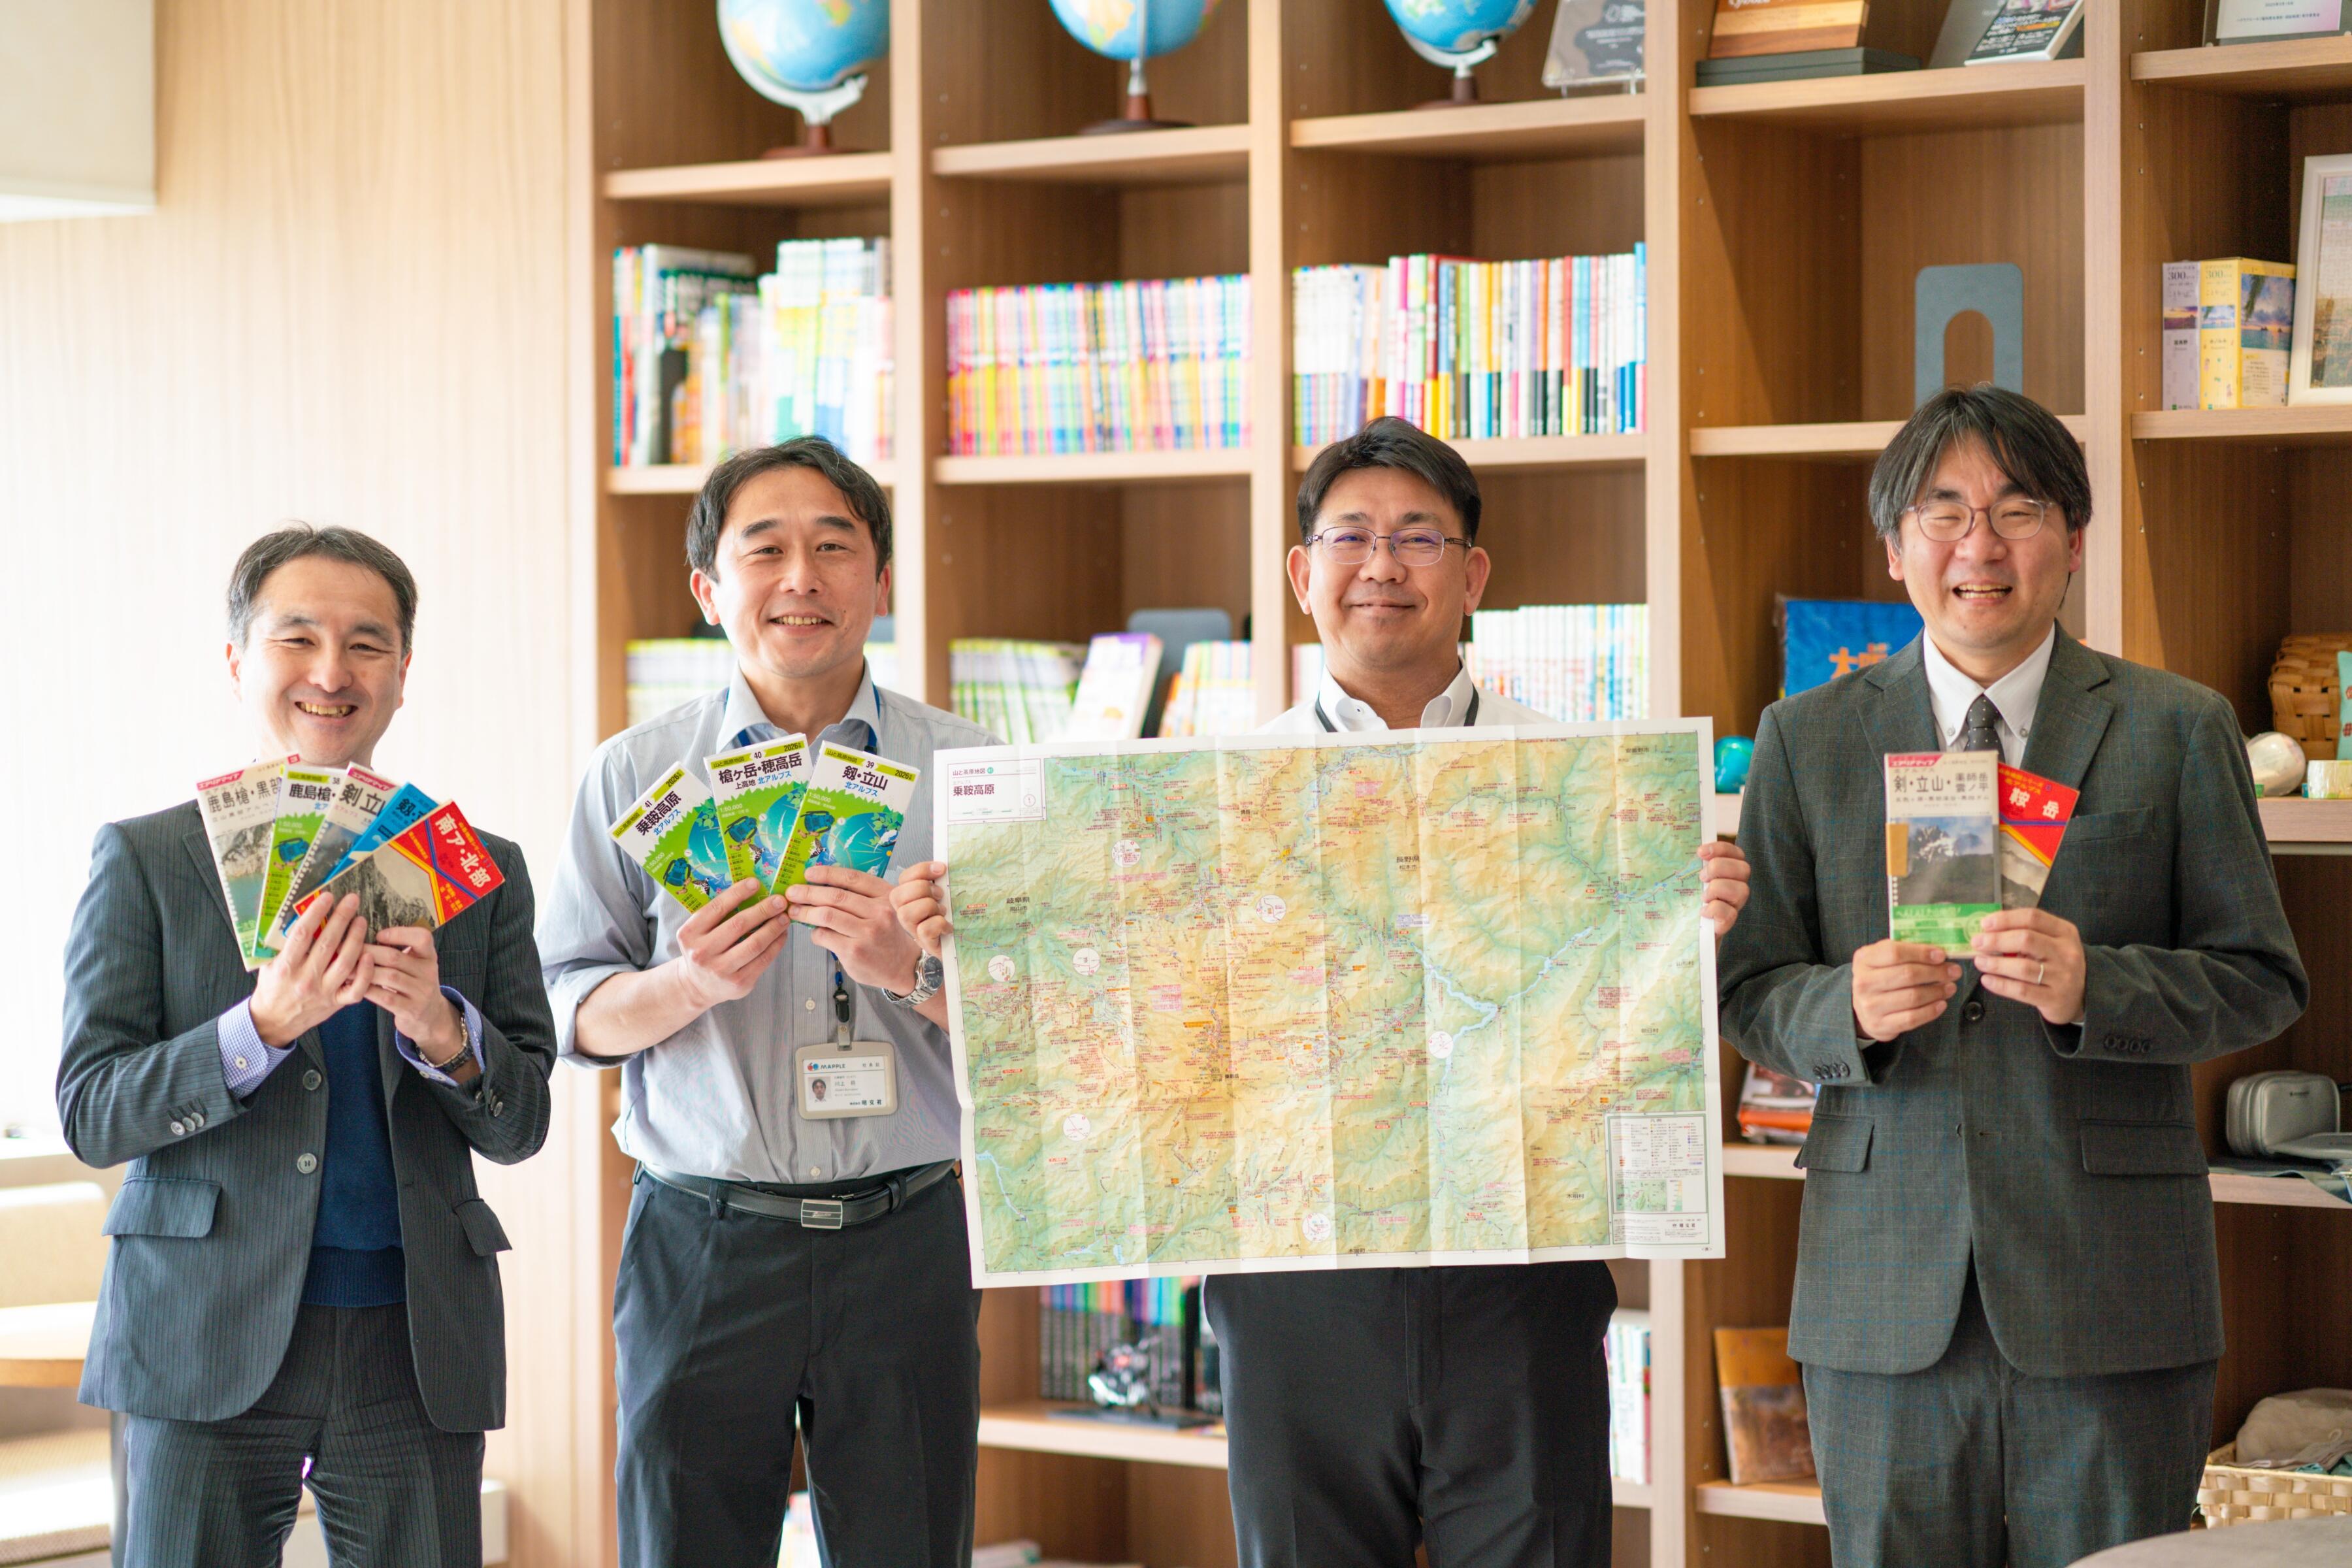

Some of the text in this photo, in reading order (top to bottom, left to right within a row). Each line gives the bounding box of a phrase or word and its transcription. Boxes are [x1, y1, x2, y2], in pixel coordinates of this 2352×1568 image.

[753, 751, 762, 759] 40
[826, 749, 858, 764] 山と高原地図
[713, 757, 745, 768] 山と高原地図
[866, 760, 874, 769] 39
[757, 771, 792, 784] 北アルプス
[952, 768, 986, 777] 山と高原地図
[735, 779, 757, 790] 上高地
[844, 781, 879, 797] 北アルプス
[952, 784, 995, 796] 乗鞍高原
[644, 800, 653, 808] 41
[635, 791, 682, 836] 乗鞍高原
[615, 812, 640, 836] 山と高原地図
[653, 808, 681, 836] 北アルプス
[434, 813, 492, 888] 南ア・北部
